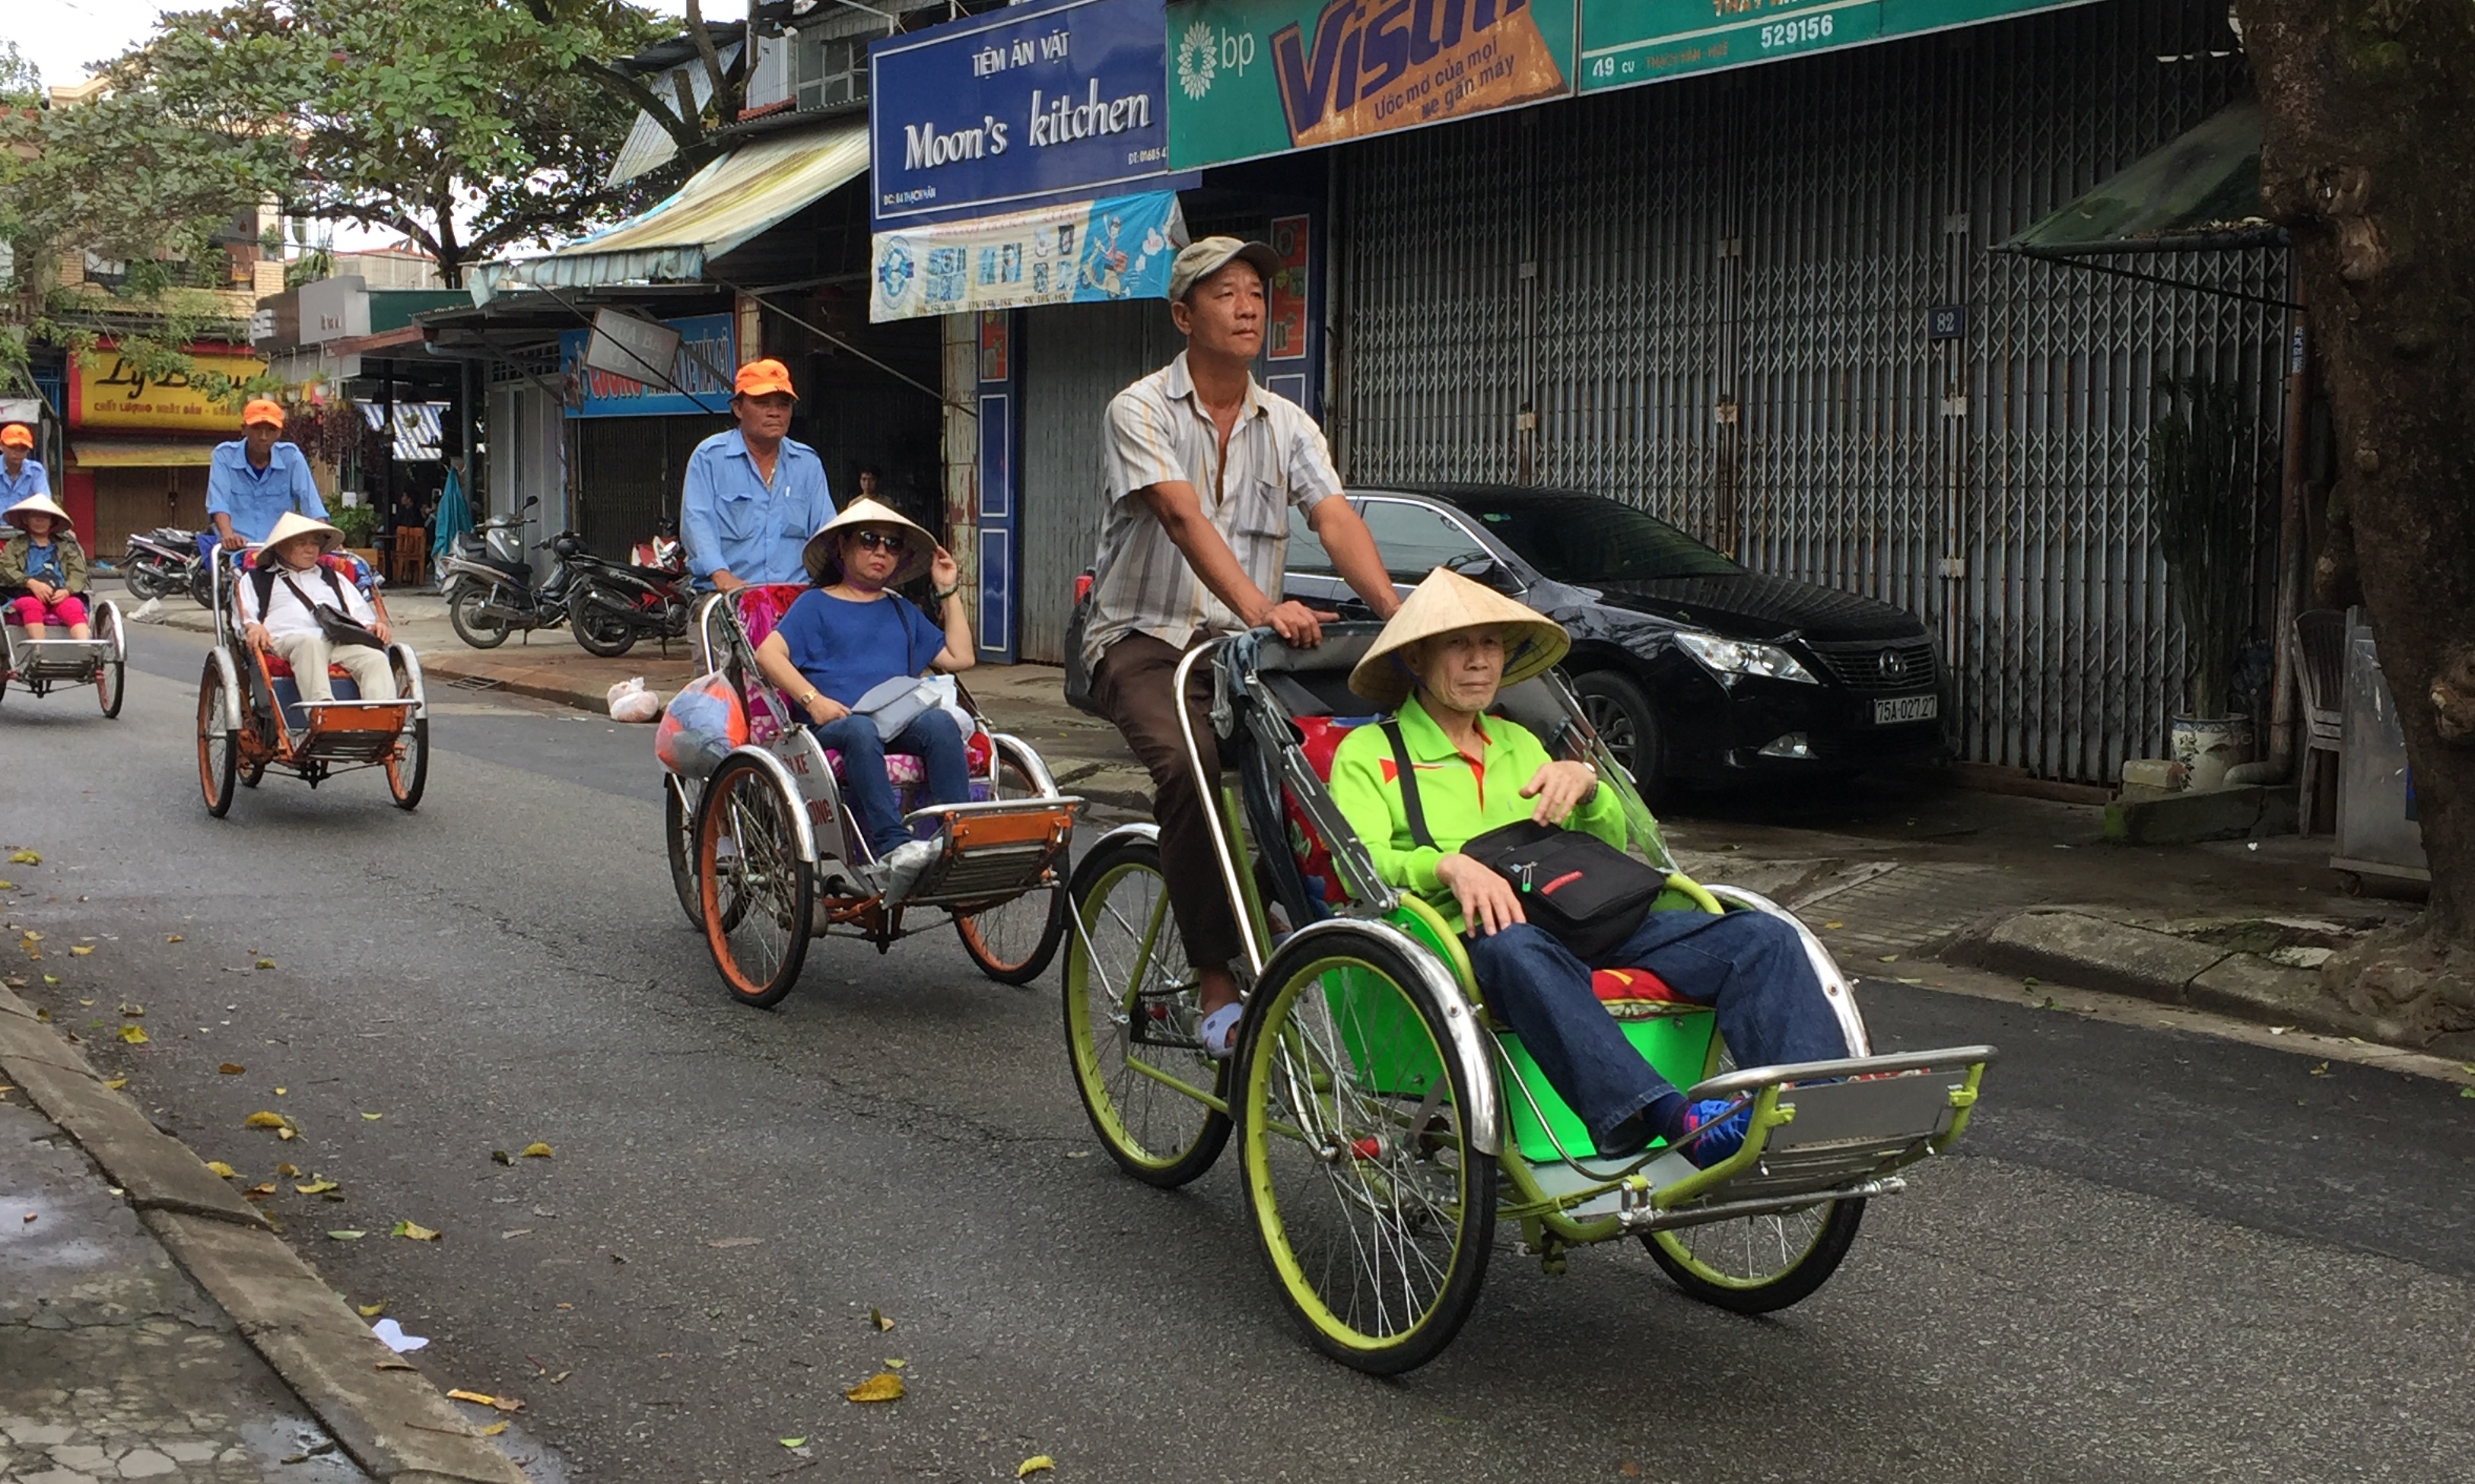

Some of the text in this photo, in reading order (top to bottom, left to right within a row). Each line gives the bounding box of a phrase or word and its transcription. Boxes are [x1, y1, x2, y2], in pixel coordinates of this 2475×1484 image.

[1761, 14, 1833, 48] 529156
[972, 28, 1069, 80] TIỆM ĂN VẶT
[1222, 27, 1254, 77] bp
[1434, 58, 1463, 87] của
[1467, 35, 1498, 69] mọi
[1592, 57, 1614, 77] 49
[1479, 54, 1514, 87] máy
[904, 78, 1152, 170] Moon's kitchen
[1937, 312, 1954, 332] 82
[794, 753, 809, 775] XE
